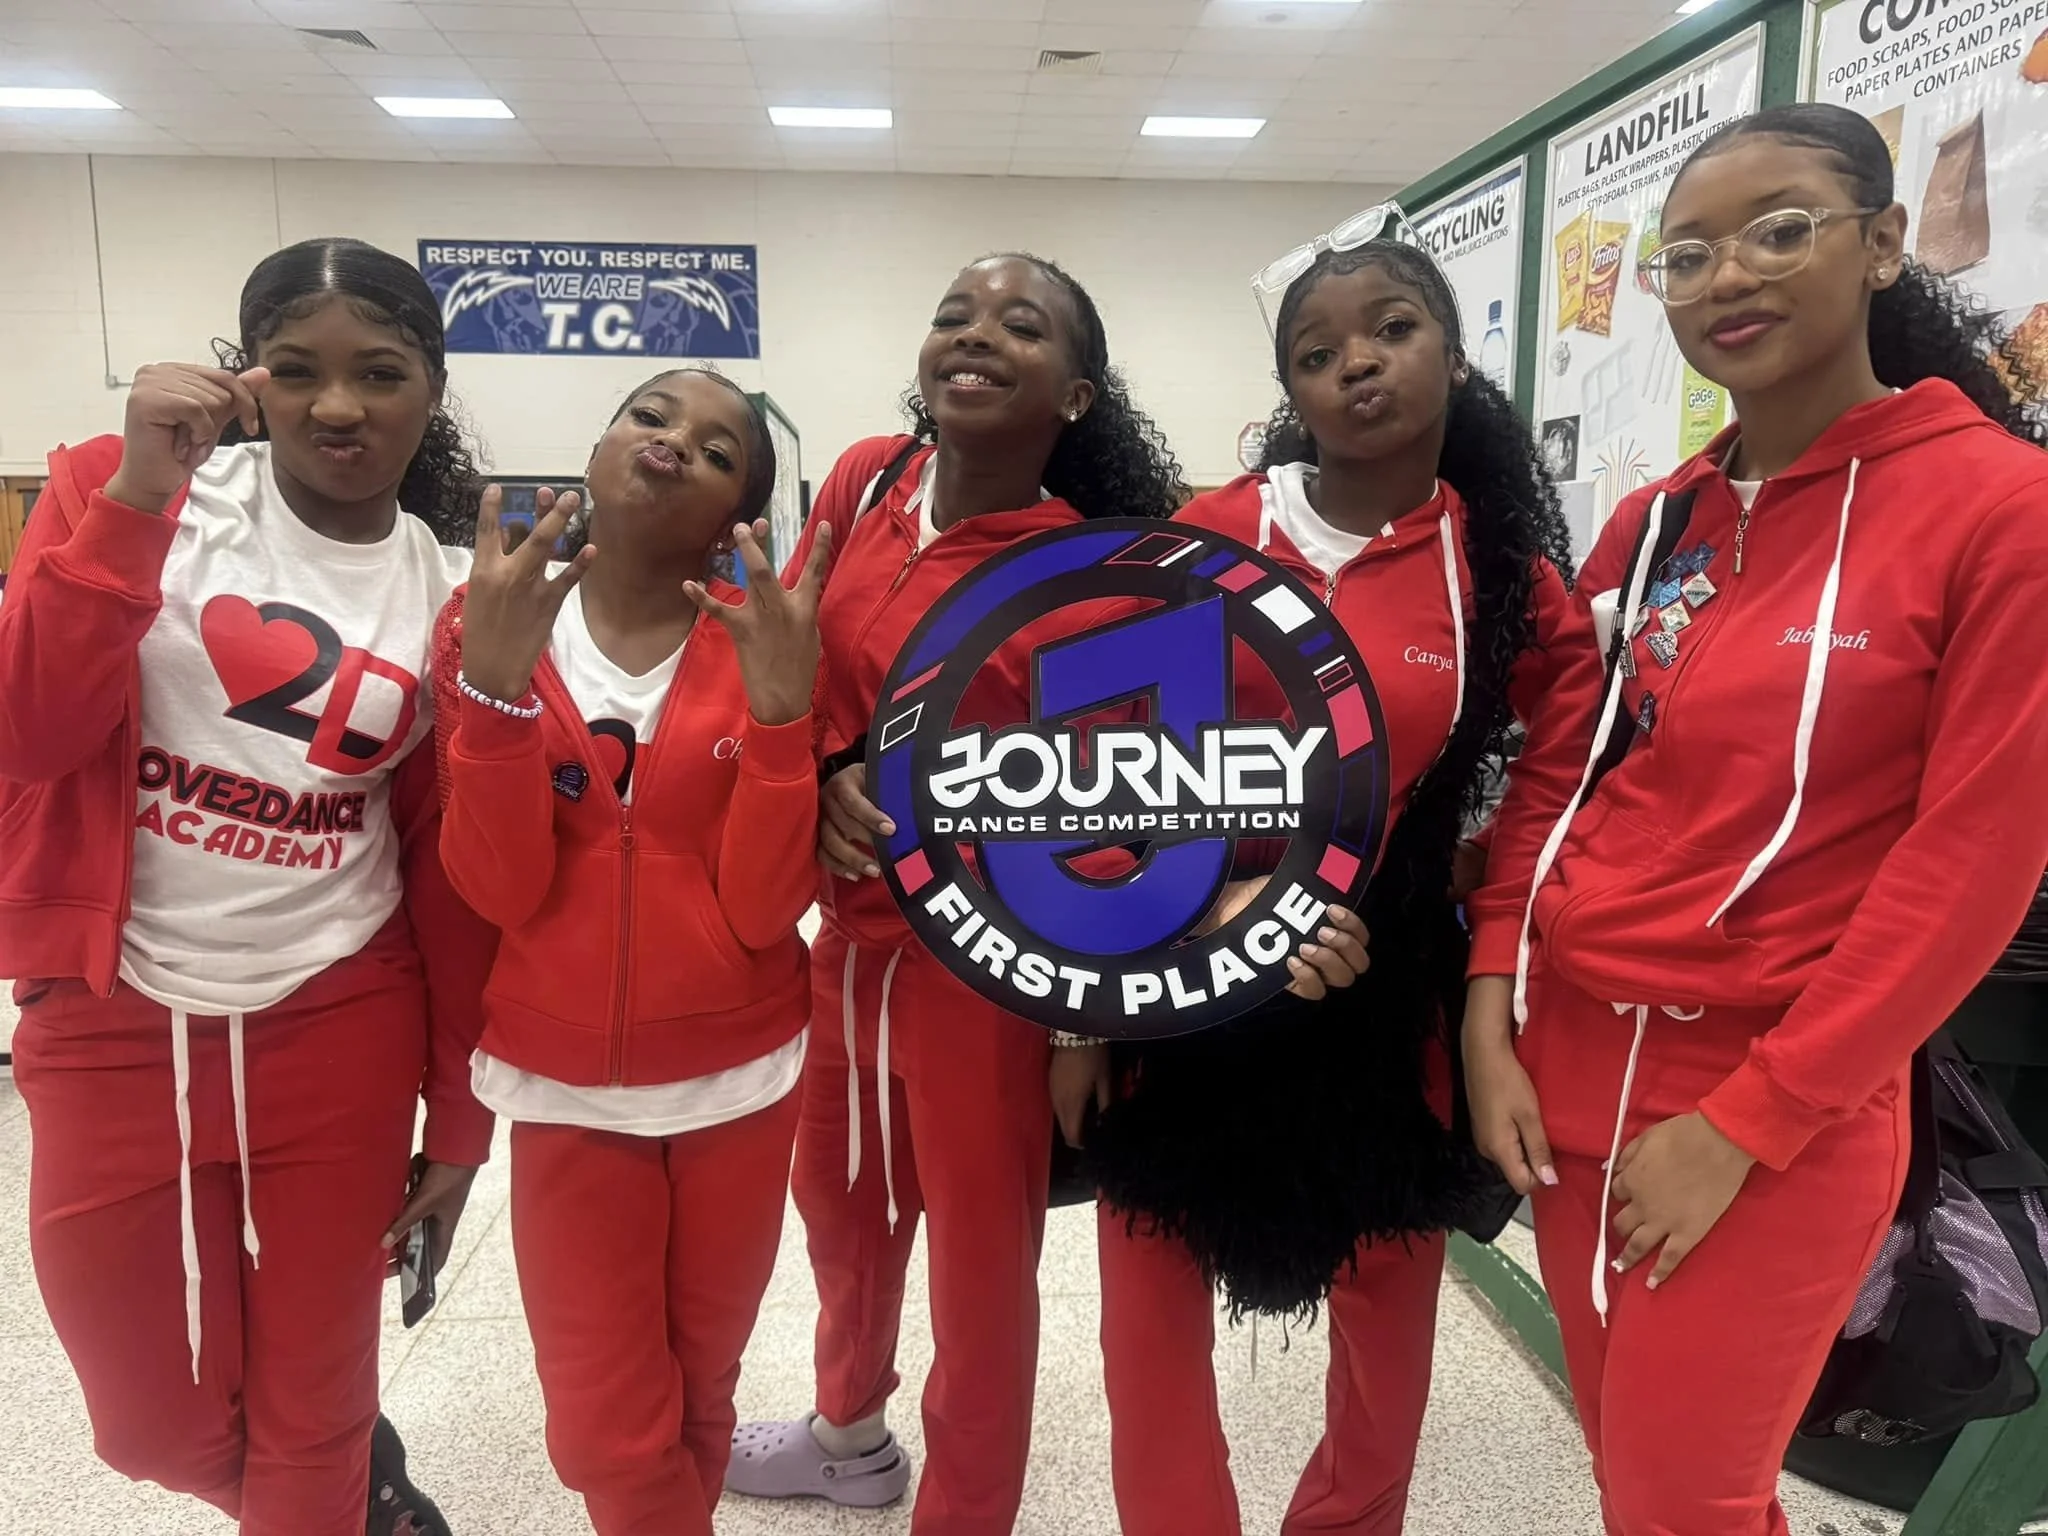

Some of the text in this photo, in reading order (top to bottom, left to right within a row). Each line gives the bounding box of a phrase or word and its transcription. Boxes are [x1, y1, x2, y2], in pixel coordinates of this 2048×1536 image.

[1828, 57, 1868, 87] FOOD
[1872, 28, 1931, 68] SCRAPS,
[1937, 2, 1984, 38] FOOD
[1845, 0, 2048, 103] PAPER PLATES AND PAPE
[1913, 39, 2022, 97] CONTAINERS
[1584, 84, 1710, 176] LANDFILL
[1601, 164, 1628, 189] PLASTIC
[1672, 130, 1704, 156] PLASTIC
[1662, 161, 1680, 179] AND
[426, 247, 750, 270] RESPECT YOU. RESPECT ME.
[536, 273, 642, 300] WE ARE
[541, 303, 645, 349] T. C.
[1404, 645, 1454, 672] Canya
[137, 745, 366, 835] OVE2DANCE
[929, 726, 1328, 809] JOURNEY
[136, 800, 343, 870] ACADEMY
[934, 810, 1301, 834] DANCE COMPETITION
[924, 881, 1327, 1015] FIRST PLACE
